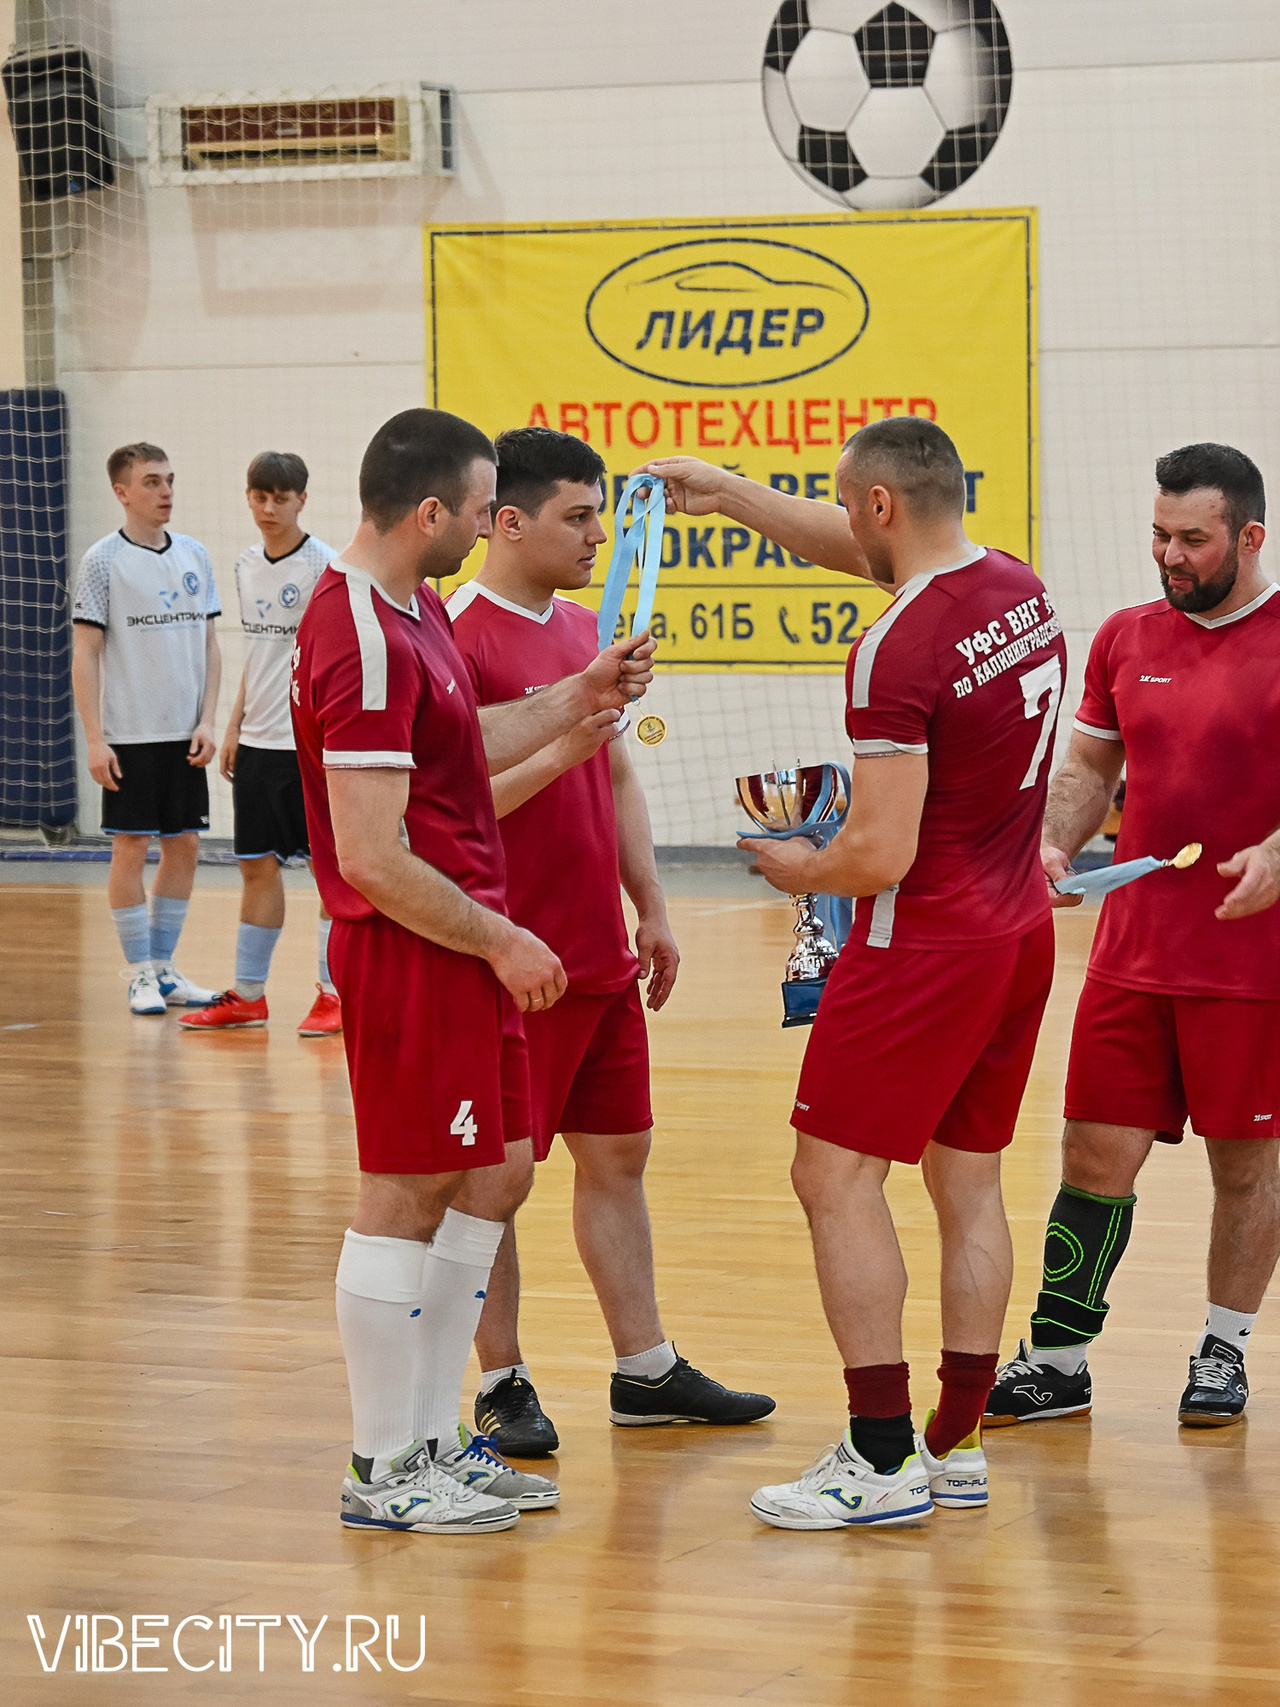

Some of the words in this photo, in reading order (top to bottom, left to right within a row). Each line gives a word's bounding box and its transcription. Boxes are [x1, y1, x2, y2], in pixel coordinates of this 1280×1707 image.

[635, 307, 825, 356] ЛИДЕР
[691, 602, 755, 641] 61Б
[955, 620, 1008, 666] УФС
[1018, 653, 1061, 791] 7
[450, 1100, 478, 1146] 4
